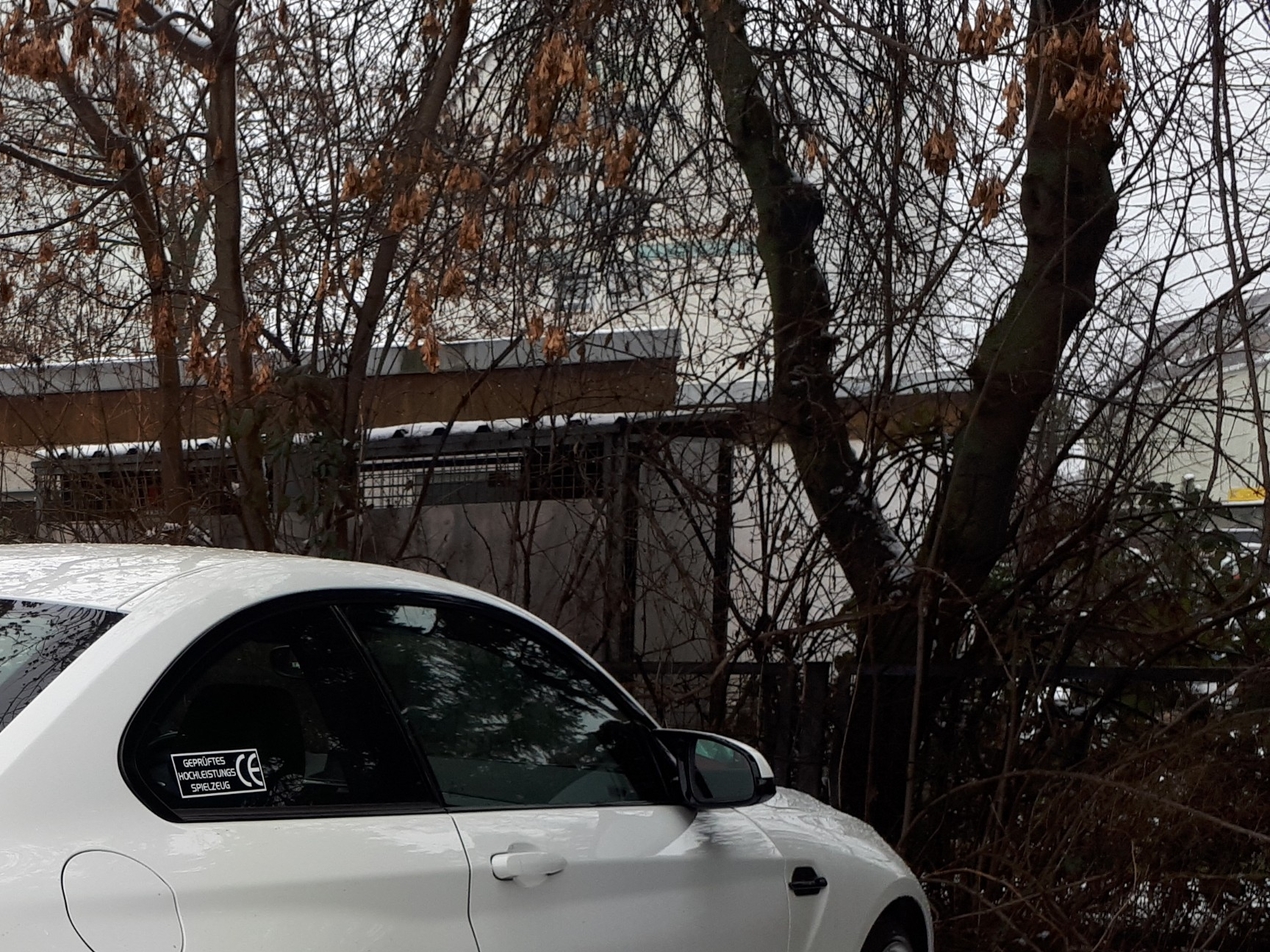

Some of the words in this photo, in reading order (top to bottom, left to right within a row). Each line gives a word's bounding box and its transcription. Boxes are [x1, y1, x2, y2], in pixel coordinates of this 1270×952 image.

[182, 756, 226, 768] GEPRÜFTES
[177, 768, 237, 781] HOCHLEISTUNGS
[190, 781, 231, 793] SPIELZEUG
